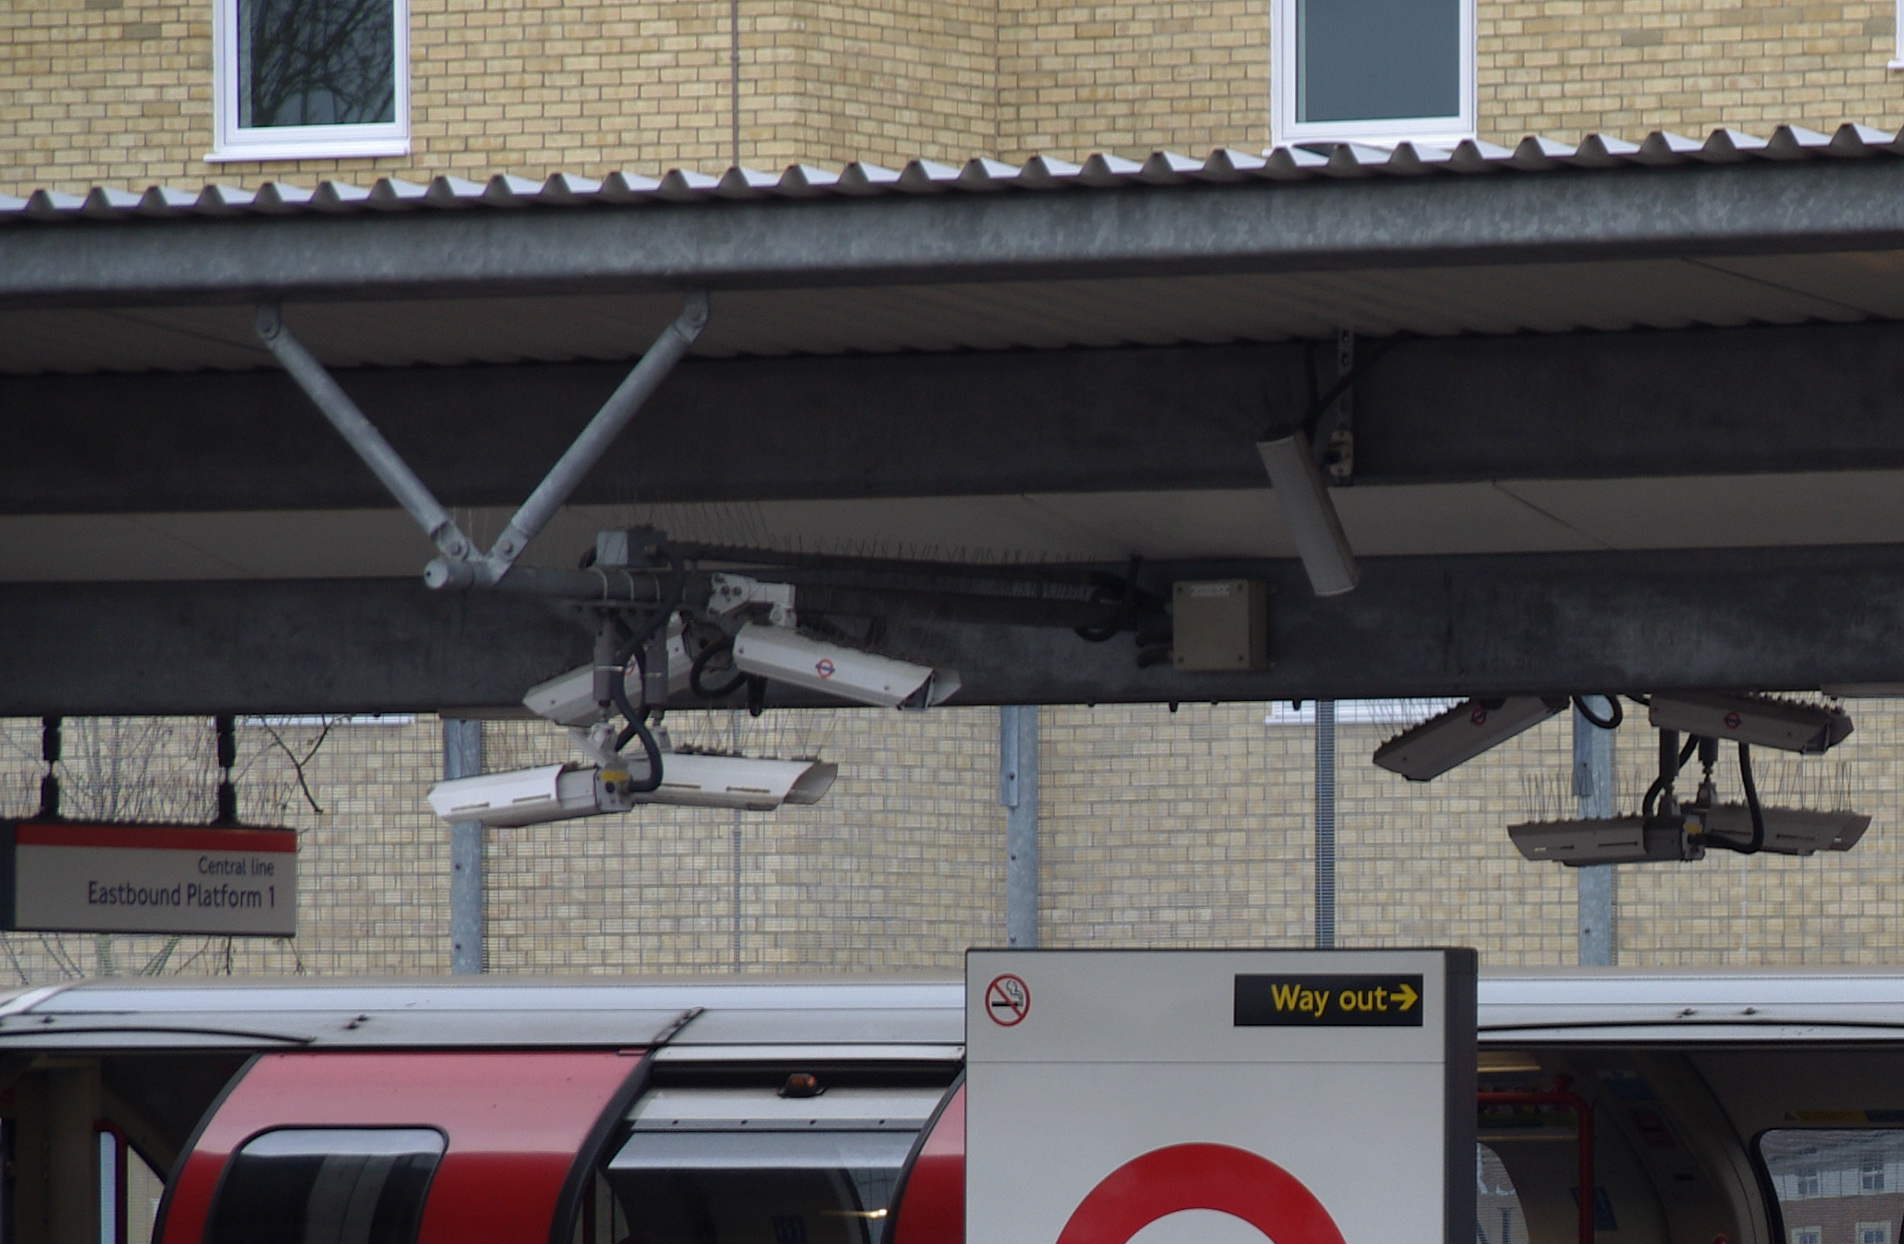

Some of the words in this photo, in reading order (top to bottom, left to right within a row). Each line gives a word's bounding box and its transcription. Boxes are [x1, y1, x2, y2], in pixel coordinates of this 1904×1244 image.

[198, 856, 246, 876] Central
[251, 858, 275, 876] line
[88, 880, 181, 907] Eastbound
[187, 883, 262, 908] Platform
[268, 884, 275, 908] 1
[1271, 983, 1330, 1018] Way
[1339, 986, 1388, 1011] out
